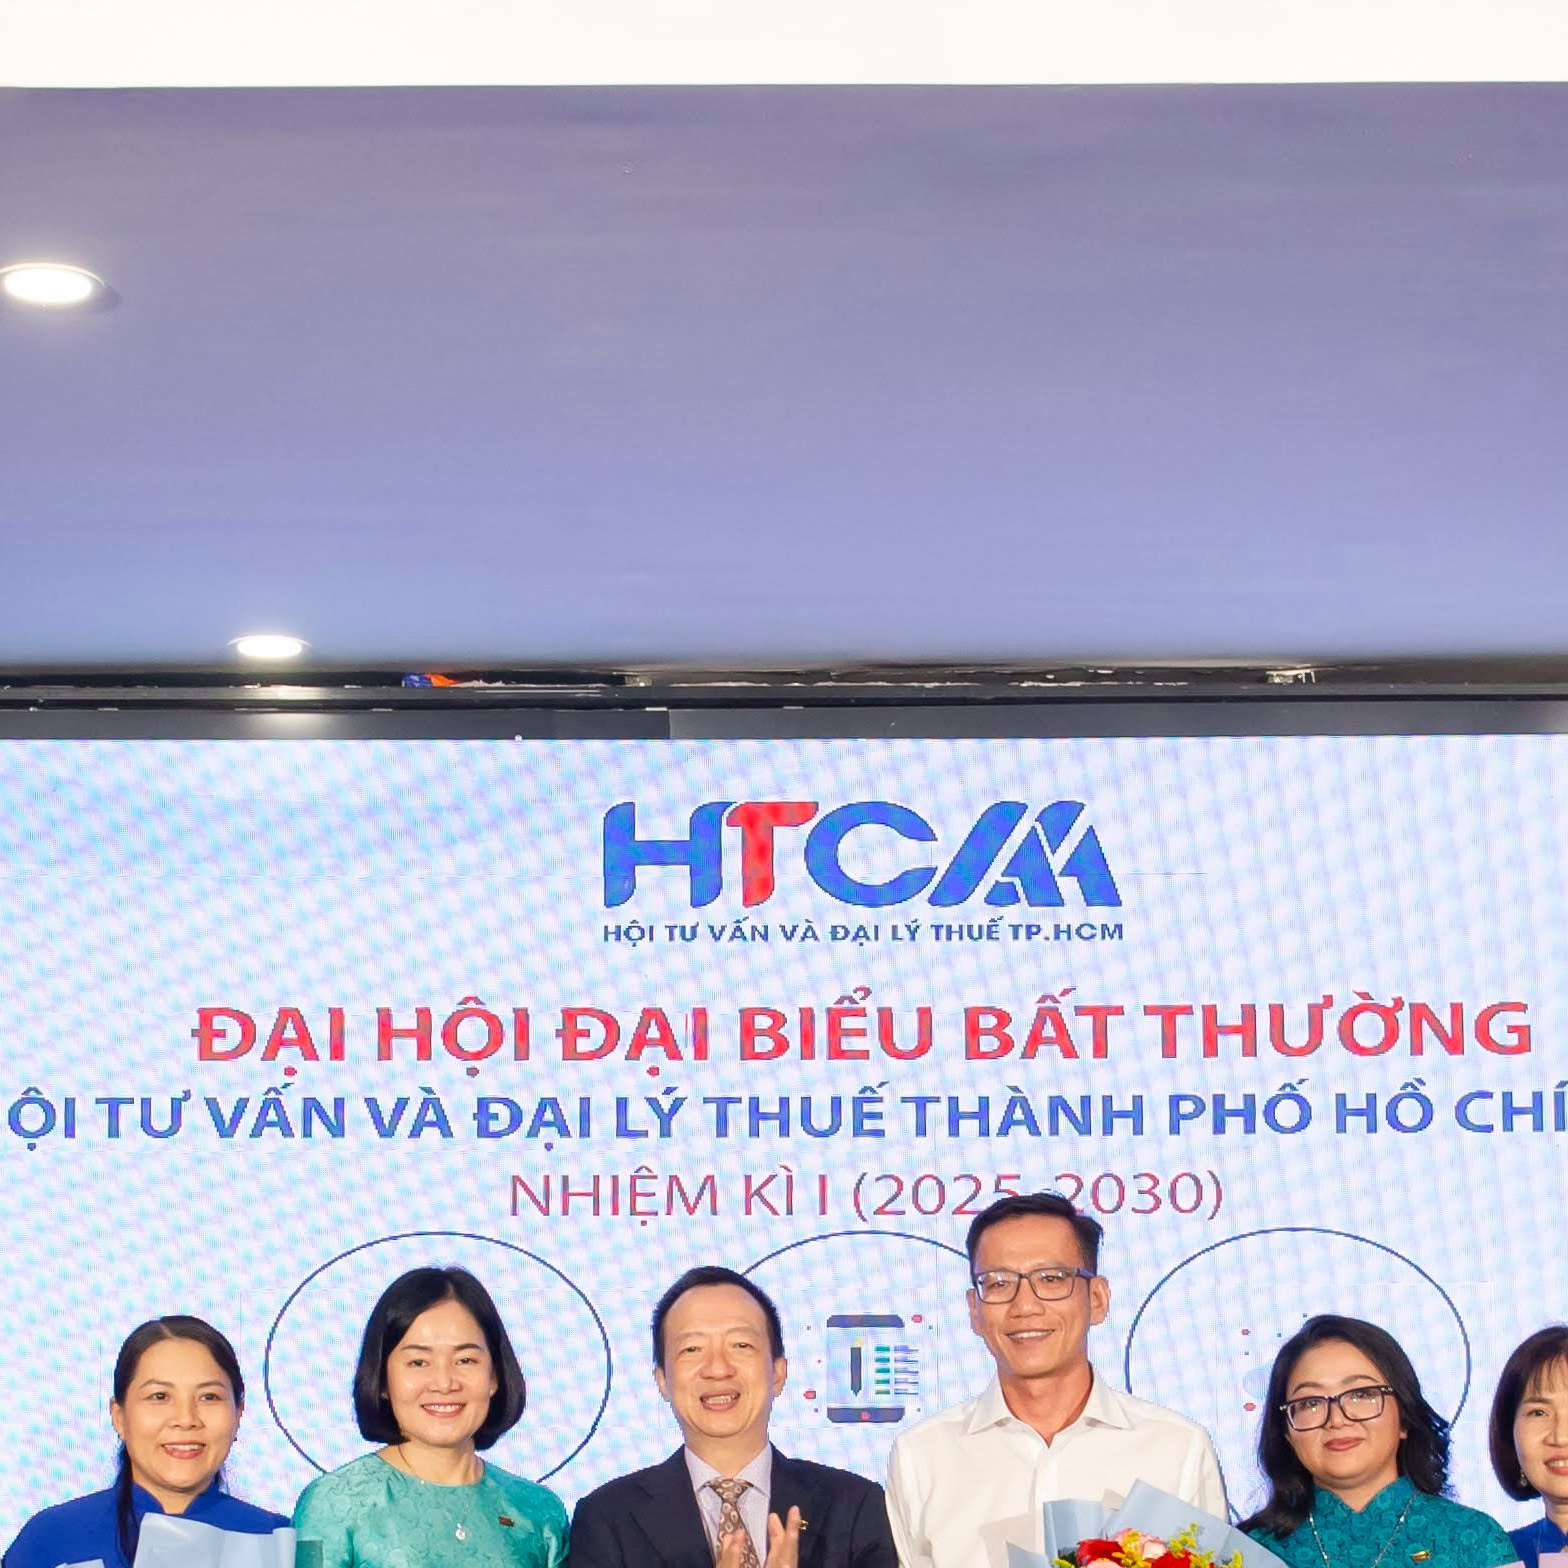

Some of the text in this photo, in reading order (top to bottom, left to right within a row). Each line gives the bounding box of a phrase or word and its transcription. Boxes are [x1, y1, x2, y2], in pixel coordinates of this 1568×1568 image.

[604, 915, 1124, 947] HỘI TƯ VẤN VÀ ĐẠI LÝ THUẾ TP.HCM
[191, 986, 1532, 1077] ĐẠI HỘI ĐẠI BIỂU BẤT THƯỜNG
[95, 1089, 191, 1139] TƯ
[204, 1082, 345, 1139] VẤN
[364, 1086, 454, 1139] VÀ
[472, 1096, 591, 1150] ĐẠI
[615, 1086, 688, 1138] LÝ
[703, 1081, 890, 1138] THUẾ
[900, 1085, 1144, 1138] THÀNH
[1168, 1078, 1312, 1136] PHỐ
[1335, 1077, 1434, 1134] HỒ
[511, 1164, 1223, 1226] NHIỆM KÌ I (20252030)
